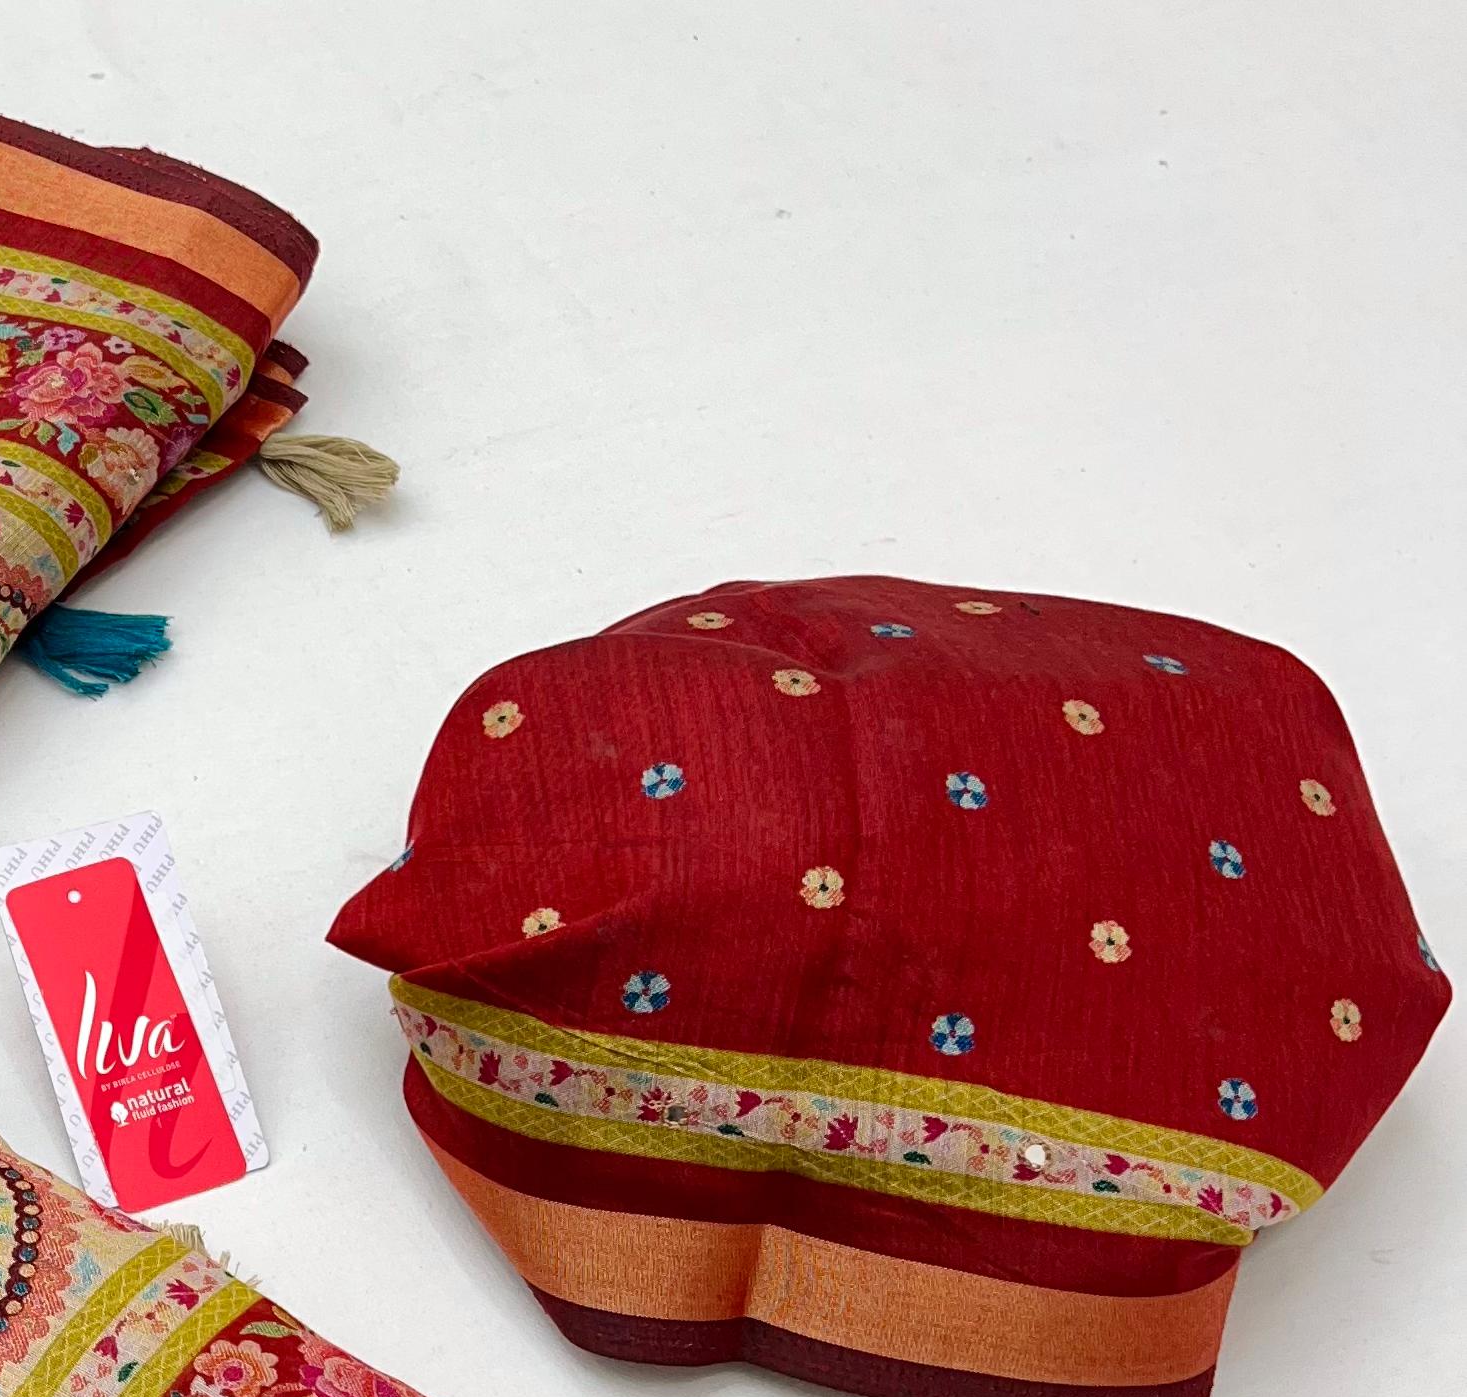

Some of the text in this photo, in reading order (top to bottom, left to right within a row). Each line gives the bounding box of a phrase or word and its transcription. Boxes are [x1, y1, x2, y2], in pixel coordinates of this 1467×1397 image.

[101, 1083, 111, 1092] BY
[137, 1060, 181, 1080] CELLULOSE
[127, 1077, 191, 1110] natural
[132, 1095, 195, 1120] fluid fashion
